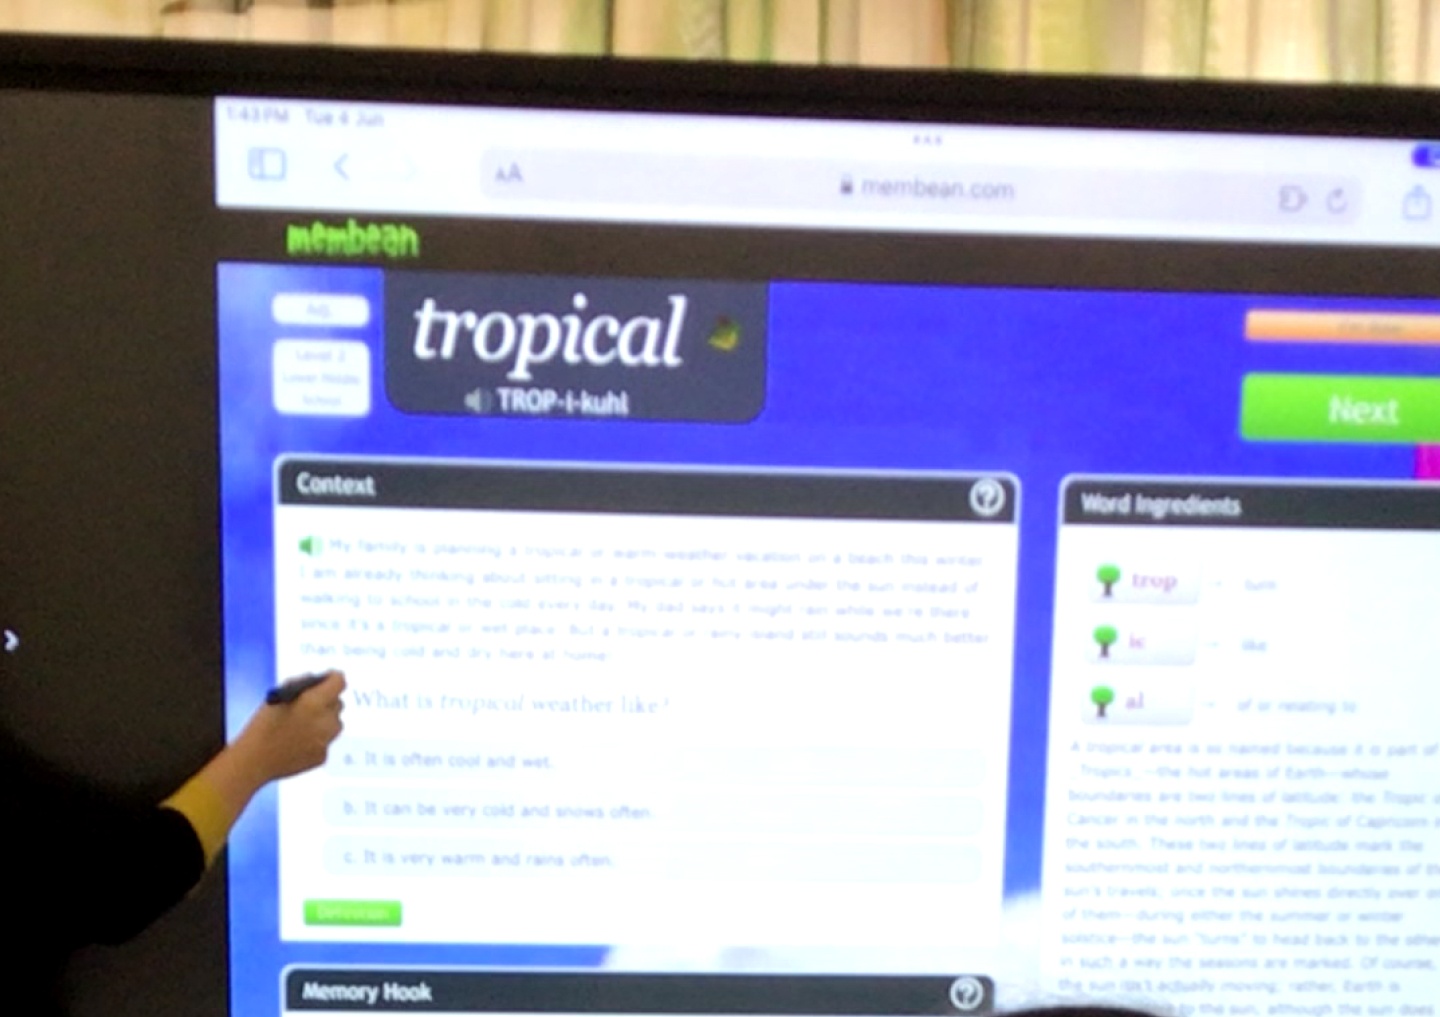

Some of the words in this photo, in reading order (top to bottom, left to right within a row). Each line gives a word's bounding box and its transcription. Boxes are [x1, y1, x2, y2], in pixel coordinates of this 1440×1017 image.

[305, 107, 334, 125] Tue
[338, 110, 349, 125] 4
[356, 110, 385, 127] Jun
[862, 173, 1014, 201] membean.com
[286, 219, 420, 258] membean
[413, 292, 689, 380] tropical
[497, 387, 628, 416] TROP-i-kuhl
[1328, 394, 1400, 427] Next
[295, 471, 376, 496] Context
[1081, 492, 1130, 514] Word
[1135, 494, 1242, 520] Ingredients
[1132, 571, 1178, 593] trop
[352, 690, 409, 709] What
[416, 696, 433, 709] is
[440, 696, 524, 714] tropical
[532, 697, 613, 712] weather
[1125, 691, 1145, 710] al
[364, 751, 378, 766] It
[382, 754, 397, 766] is
[401, 752, 443, 767] often
[448, 755, 481, 768] cool
[486, 755, 516, 768] and
[364, 800, 378, 815] It
[383, 804, 412, 816] can
[416, 802, 437, 816] be
[442, 805, 477, 818] very
[482, 804, 515, 817] cold
[520, 805, 550, 818] and
[555, 808, 605, 818] snows
[363, 849, 377, 864] It
[382, 852, 396, 864] is
[400, 854, 435, 866] very
[440, 853, 485, 865] warm
[491, 853, 521, 866] and
[526, 855, 565, 867] rains
[302, 981, 379, 1005] Memory
[382, 981, 433, 1003] Hook
